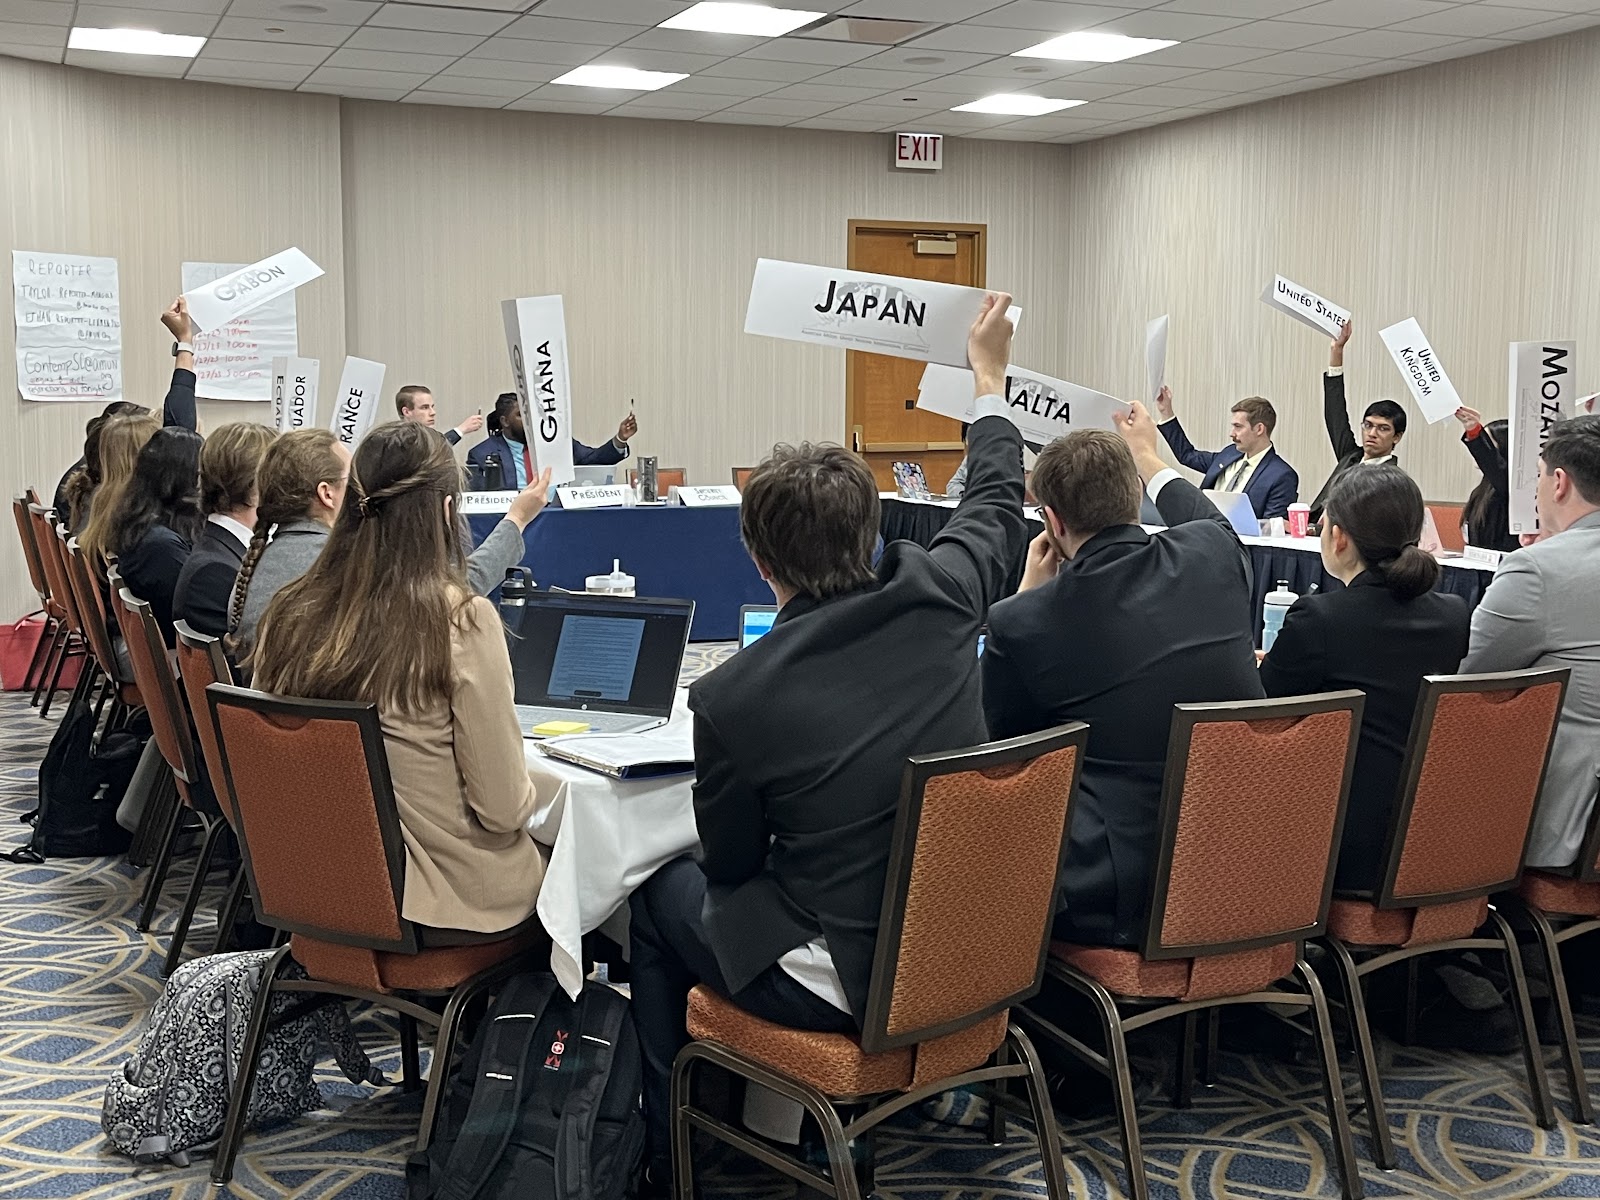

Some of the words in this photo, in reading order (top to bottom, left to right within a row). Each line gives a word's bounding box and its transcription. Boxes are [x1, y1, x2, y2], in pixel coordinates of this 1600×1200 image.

[898, 135, 940, 161] EXIT
[213, 265, 285, 302] GABON
[814, 280, 926, 327] JAPAN
[1277, 280, 1312, 307] UNITED
[1315, 300, 1346, 328] STATES
[1400, 346, 1432, 397] KINGDOM
[1418, 348, 1441, 382] UNITED
[293, 375, 306, 429] UADOR
[536, 340, 558, 443] GHANA
[341, 387, 364, 444] RANCE
[571, 488, 622, 500] PRESIDENT
